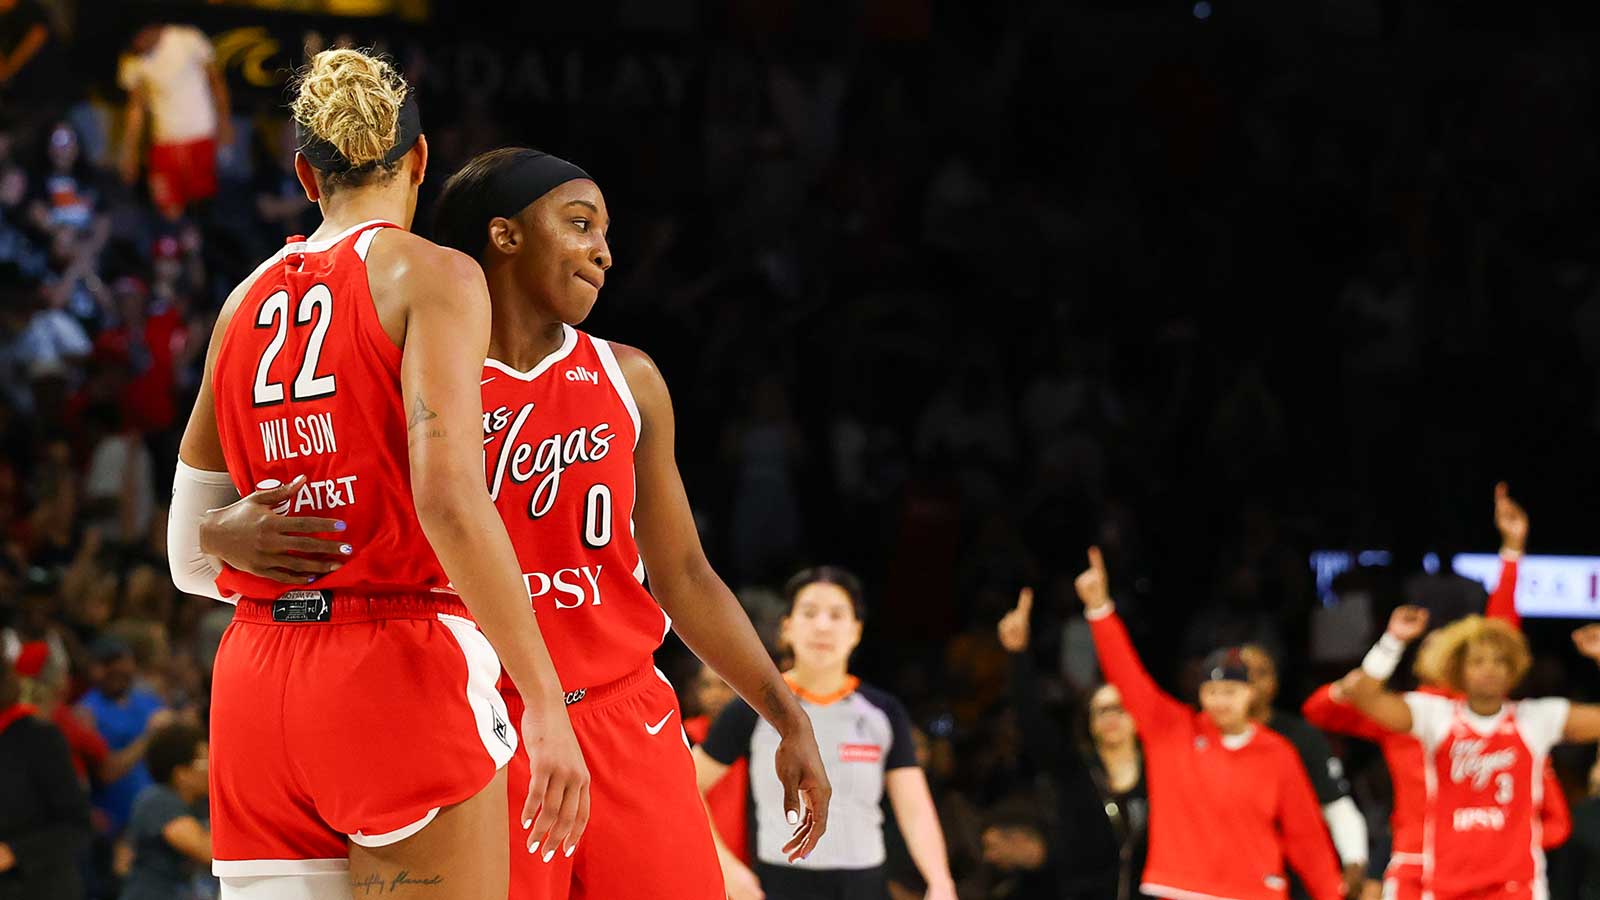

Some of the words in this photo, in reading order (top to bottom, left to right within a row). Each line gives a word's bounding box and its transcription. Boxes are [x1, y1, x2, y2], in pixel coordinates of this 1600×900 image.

[252, 282, 337, 408] 22
[565, 366, 599, 385] ally
[259, 412, 337, 462] WILSON
[483, 402, 616, 520] Vegas
[294, 475, 358, 513] AT&T
[581, 483, 613, 550] 0
[522, 565, 603, 612] PSY
[562, 688, 588, 705] ces
[1494, 772, 1514, 805] 3
